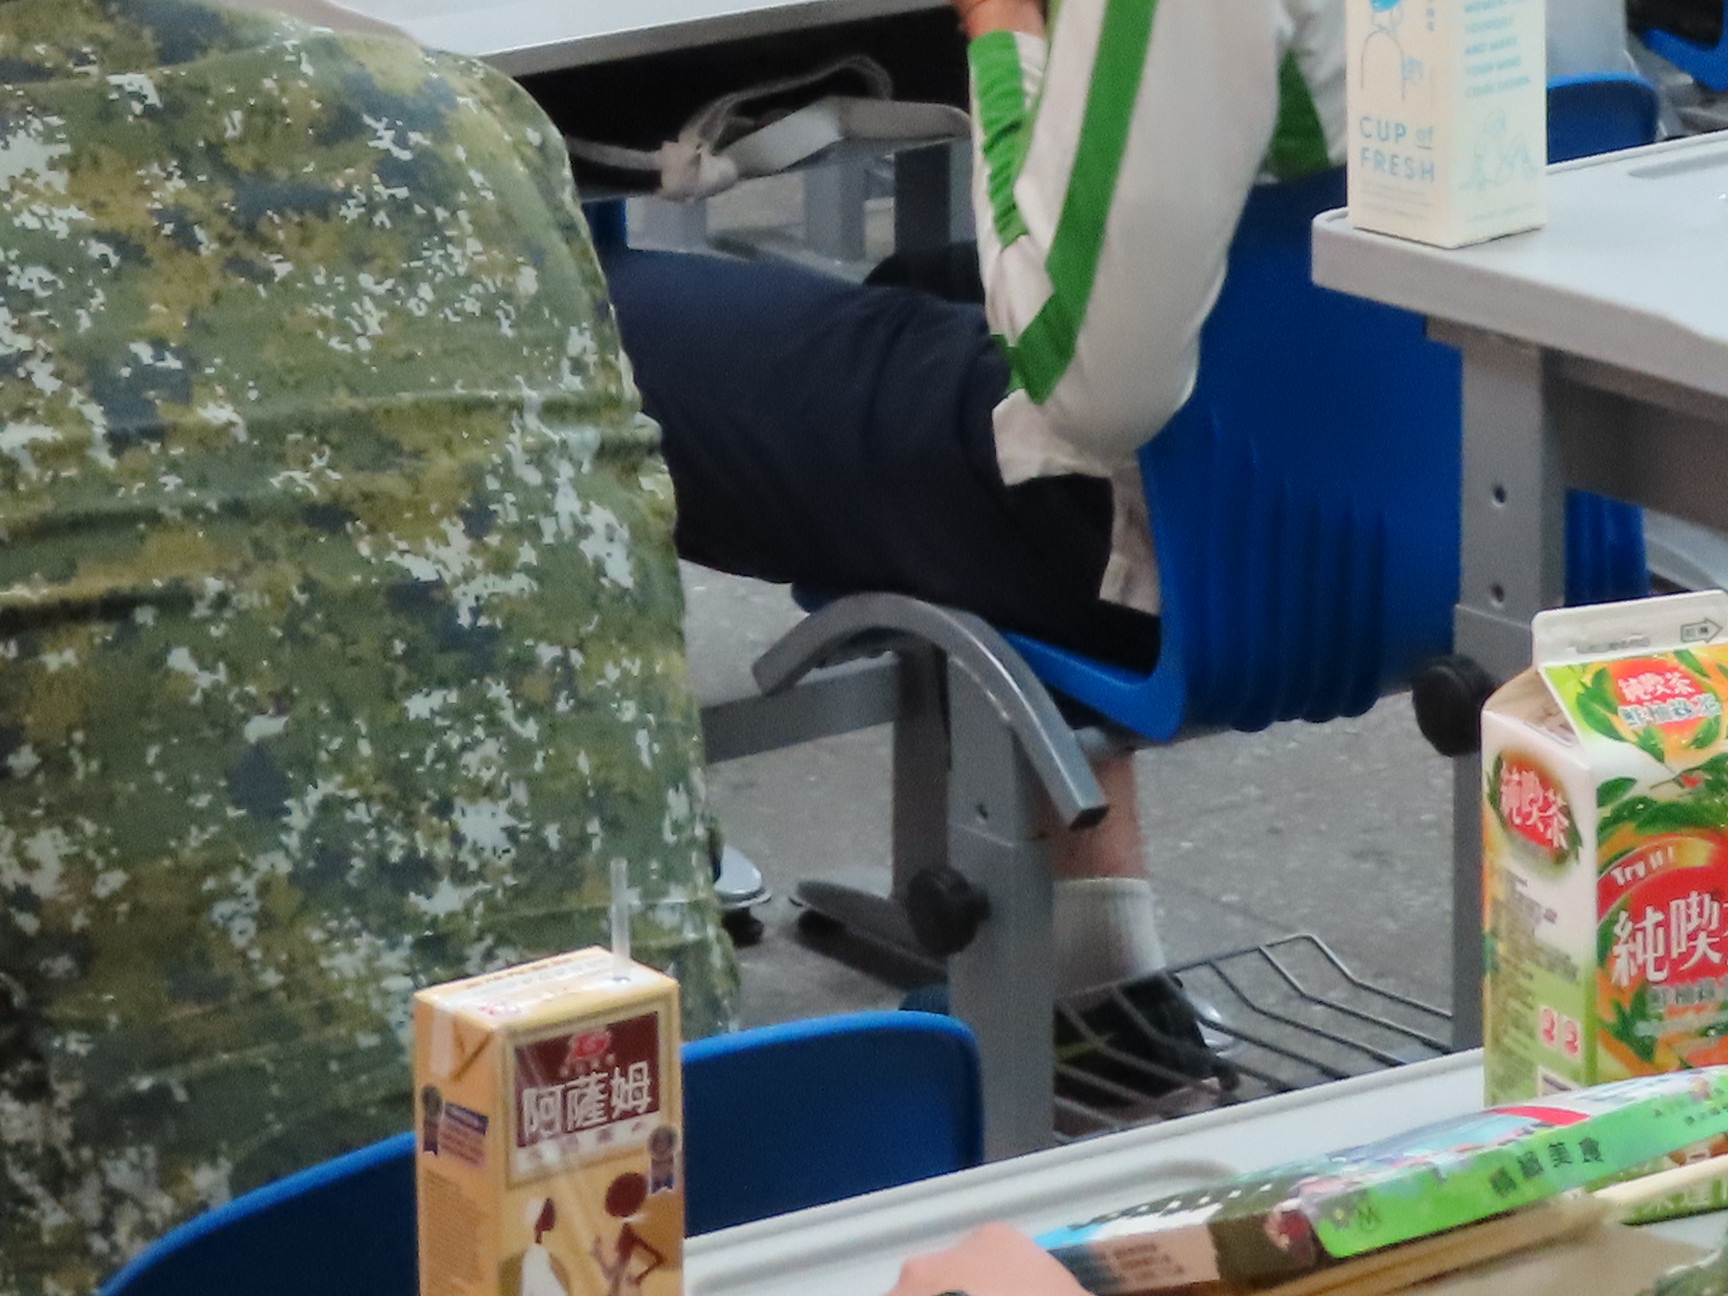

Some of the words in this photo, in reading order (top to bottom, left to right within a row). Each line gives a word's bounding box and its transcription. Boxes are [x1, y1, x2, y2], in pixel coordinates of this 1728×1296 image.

[1359, 116, 1407, 144] CUP
[1359, 147, 1436, 183] FRESH
[1609, 860, 1647, 887] Try
[522, 1060, 652, 1140] 阿薩姆
